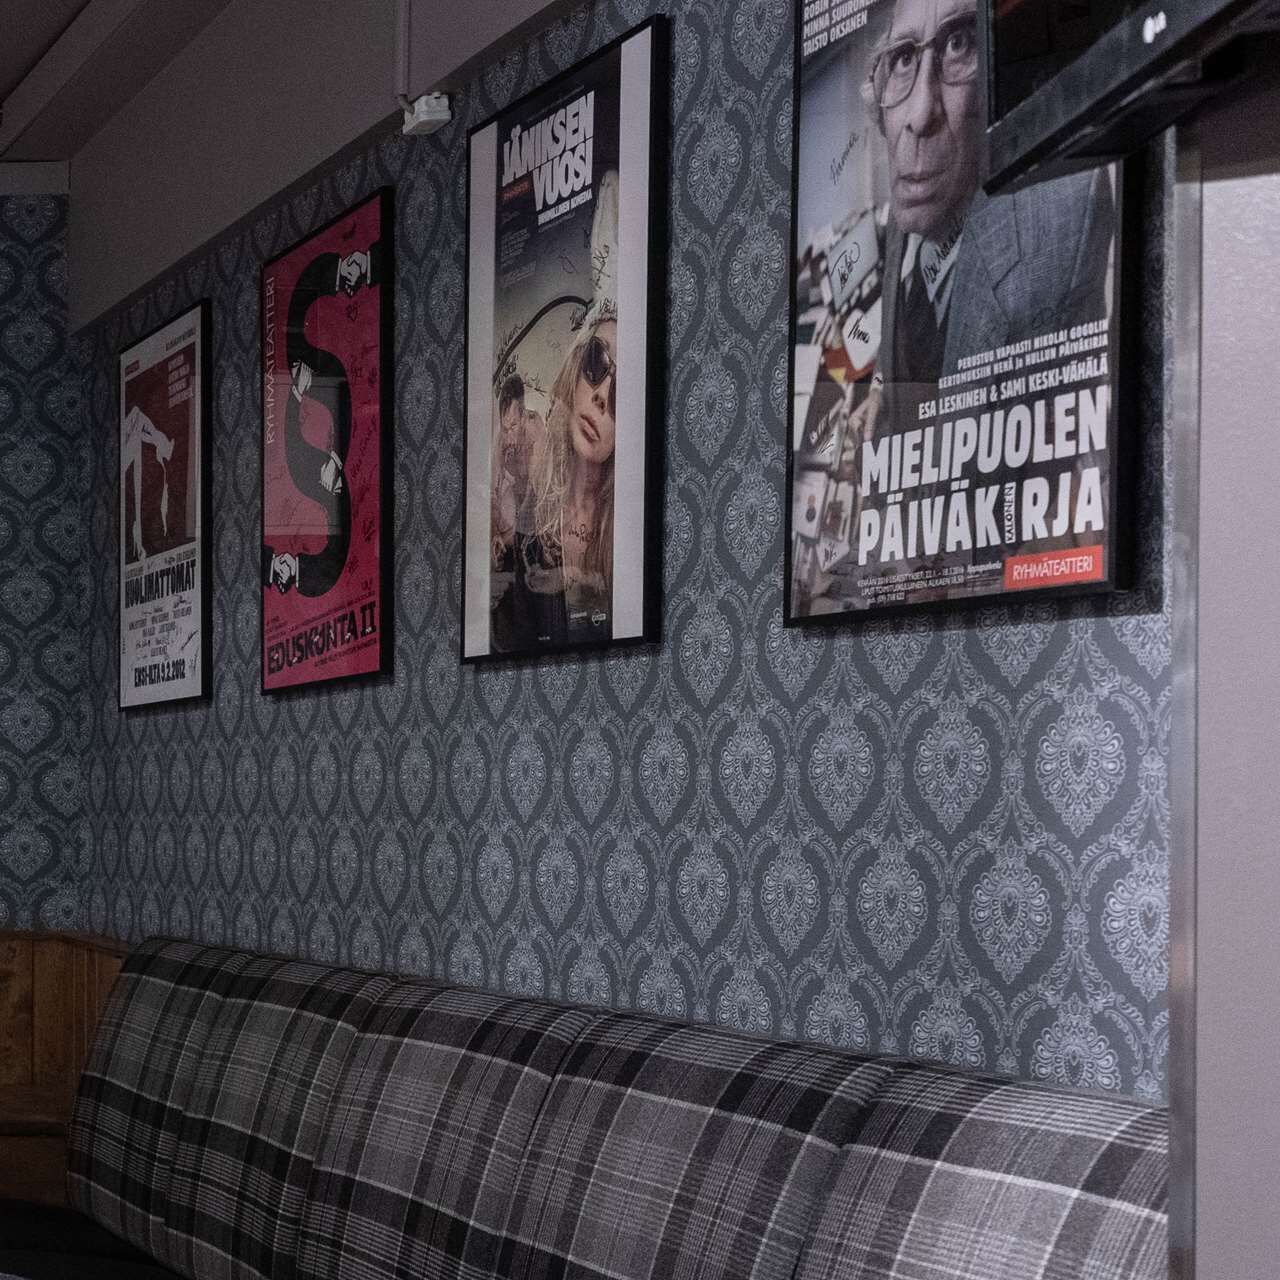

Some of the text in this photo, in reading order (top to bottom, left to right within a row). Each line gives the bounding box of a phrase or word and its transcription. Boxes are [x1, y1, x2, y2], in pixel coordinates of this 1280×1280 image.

[803, 10, 868, 56] TAISTO OKSANEN
[804, 13, 830, 39] MINNA
[502, 90, 595, 187] JÄNIKSEN
[532, 137, 593, 212] VUOSI
[264, 276, 276, 444] RYHMÄTEATTERI
[938, 363, 992, 390] KERTOMUKSIIN
[993, 356, 1014, 375] NENÄ
[1025, 347, 1056, 366] HULLUN
[1058, 332, 1110, 358] PÄIVÄKIRJA
[957, 318, 1110, 371] PERUSTUU VAPAASTI NIKOLAI GOGOLIN
[918, 353, 1110, 420] ESA LESKINEN & SAMI KESKI-VÄHÄLÄ
[861, 384, 1110, 497] MIELIPUOLEN
[1004, 483, 1017, 543] KALONEN
[1012, 555, 1094, 580] RYHMÄTEATTERI
[268, 610, 358, 675] EDUSKUNTA
[360, 601, 377, 638] II
